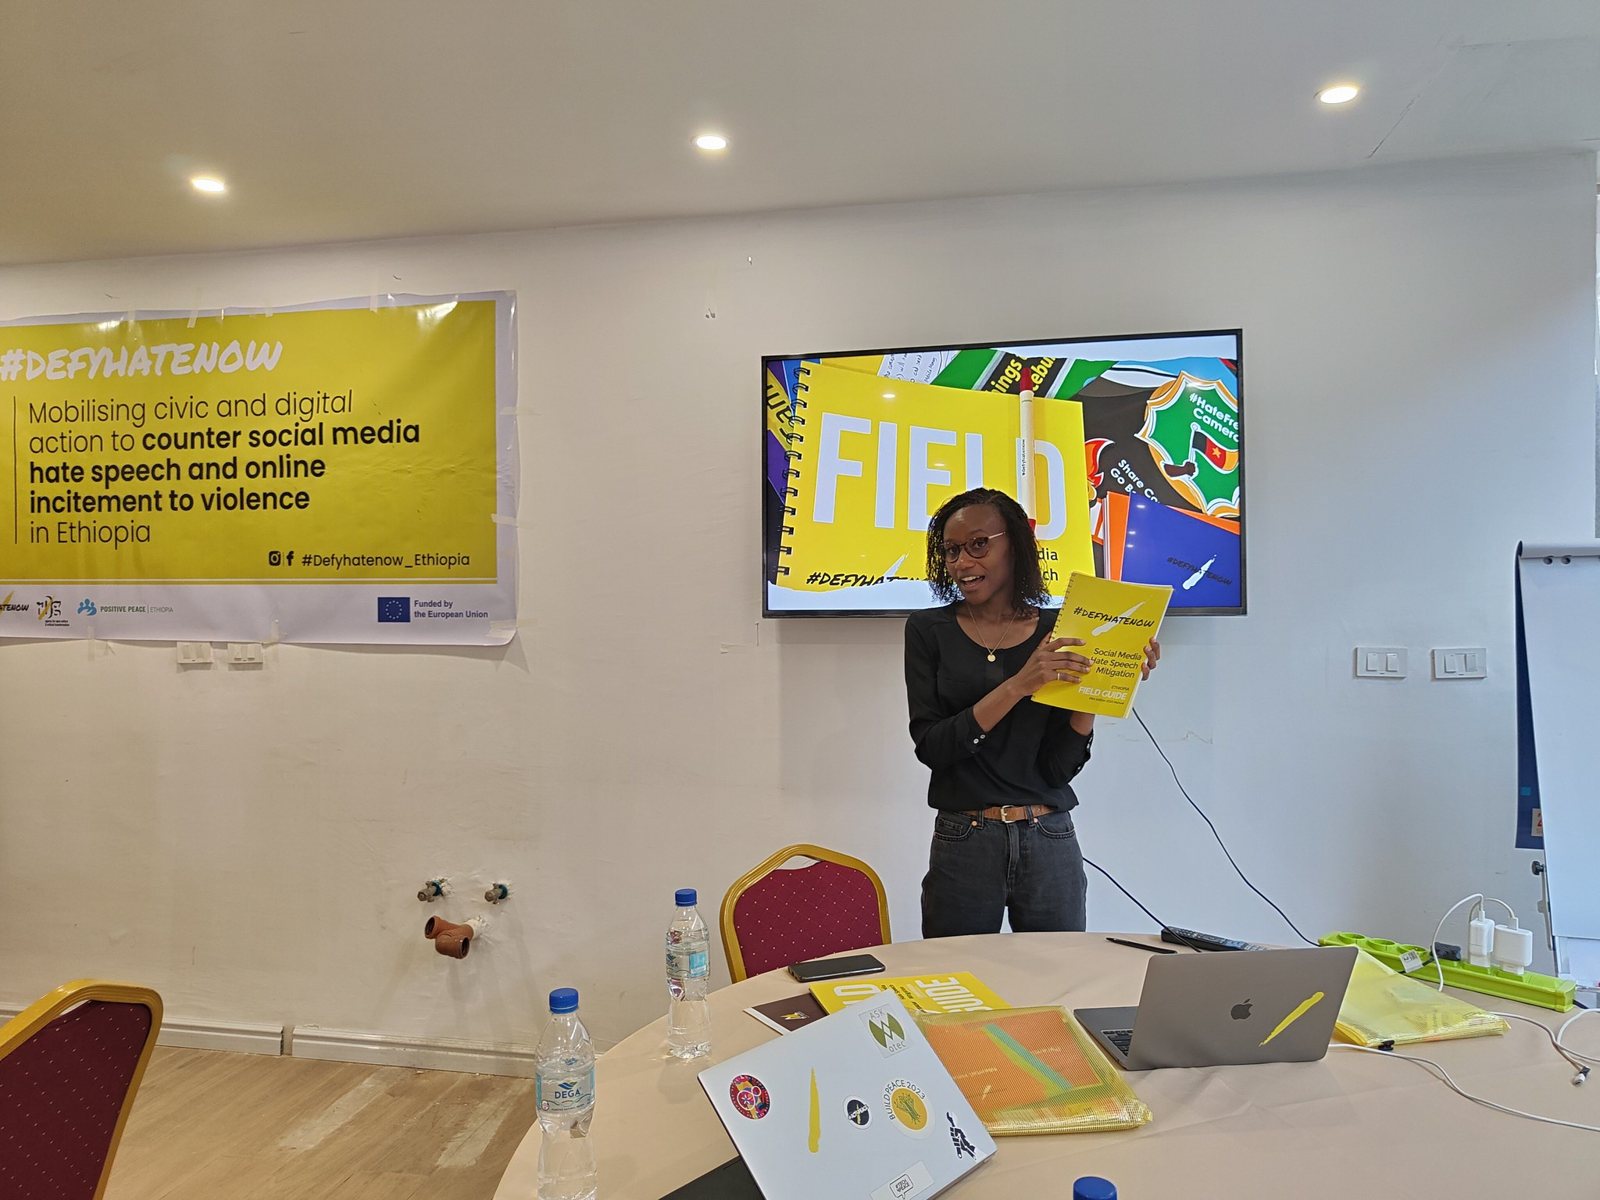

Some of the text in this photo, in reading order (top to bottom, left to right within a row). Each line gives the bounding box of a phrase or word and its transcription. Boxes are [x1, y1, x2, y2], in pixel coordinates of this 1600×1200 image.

[0, 340, 283, 381] #DEFYHATENOW
[990, 359, 1022, 393] ings
[29, 389, 353, 428] Mobilising civic and digital
[29, 419, 421, 455] action to counter social media
[30, 454, 326, 489] hate speech and online
[1111, 468, 1125, 485] Go
[1118, 459, 1144, 488] Share
[30, 487, 310, 515] incitement to violence
[30, 521, 151, 550] in Ethiopia
[301, 553, 471, 571] #Defyhatenow_Ethiopia
[100, 605, 126, 613] POSITIVE
[128, 605, 146, 613] PEACE
[414, 600, 453, 609] Funded by
[414, 610, 489, 619] the European Union
[1073, 606, 1155, 628] #DEFYHATENOW
[1094, 647, 1142, 661] Social Media
[1095, 666, 1135, 679] Mitigation
[1110, 659, 1139, 670] Speech
[1078, 686, 1128, 700] FIELD GUIDE
[554, 1088, 581, 1099] DEGA
[885, 1079, 906, 1094] PEACE
[906, 1081, 926, 1100] 2023
[883, 1093, 896, 1120] BUILD
